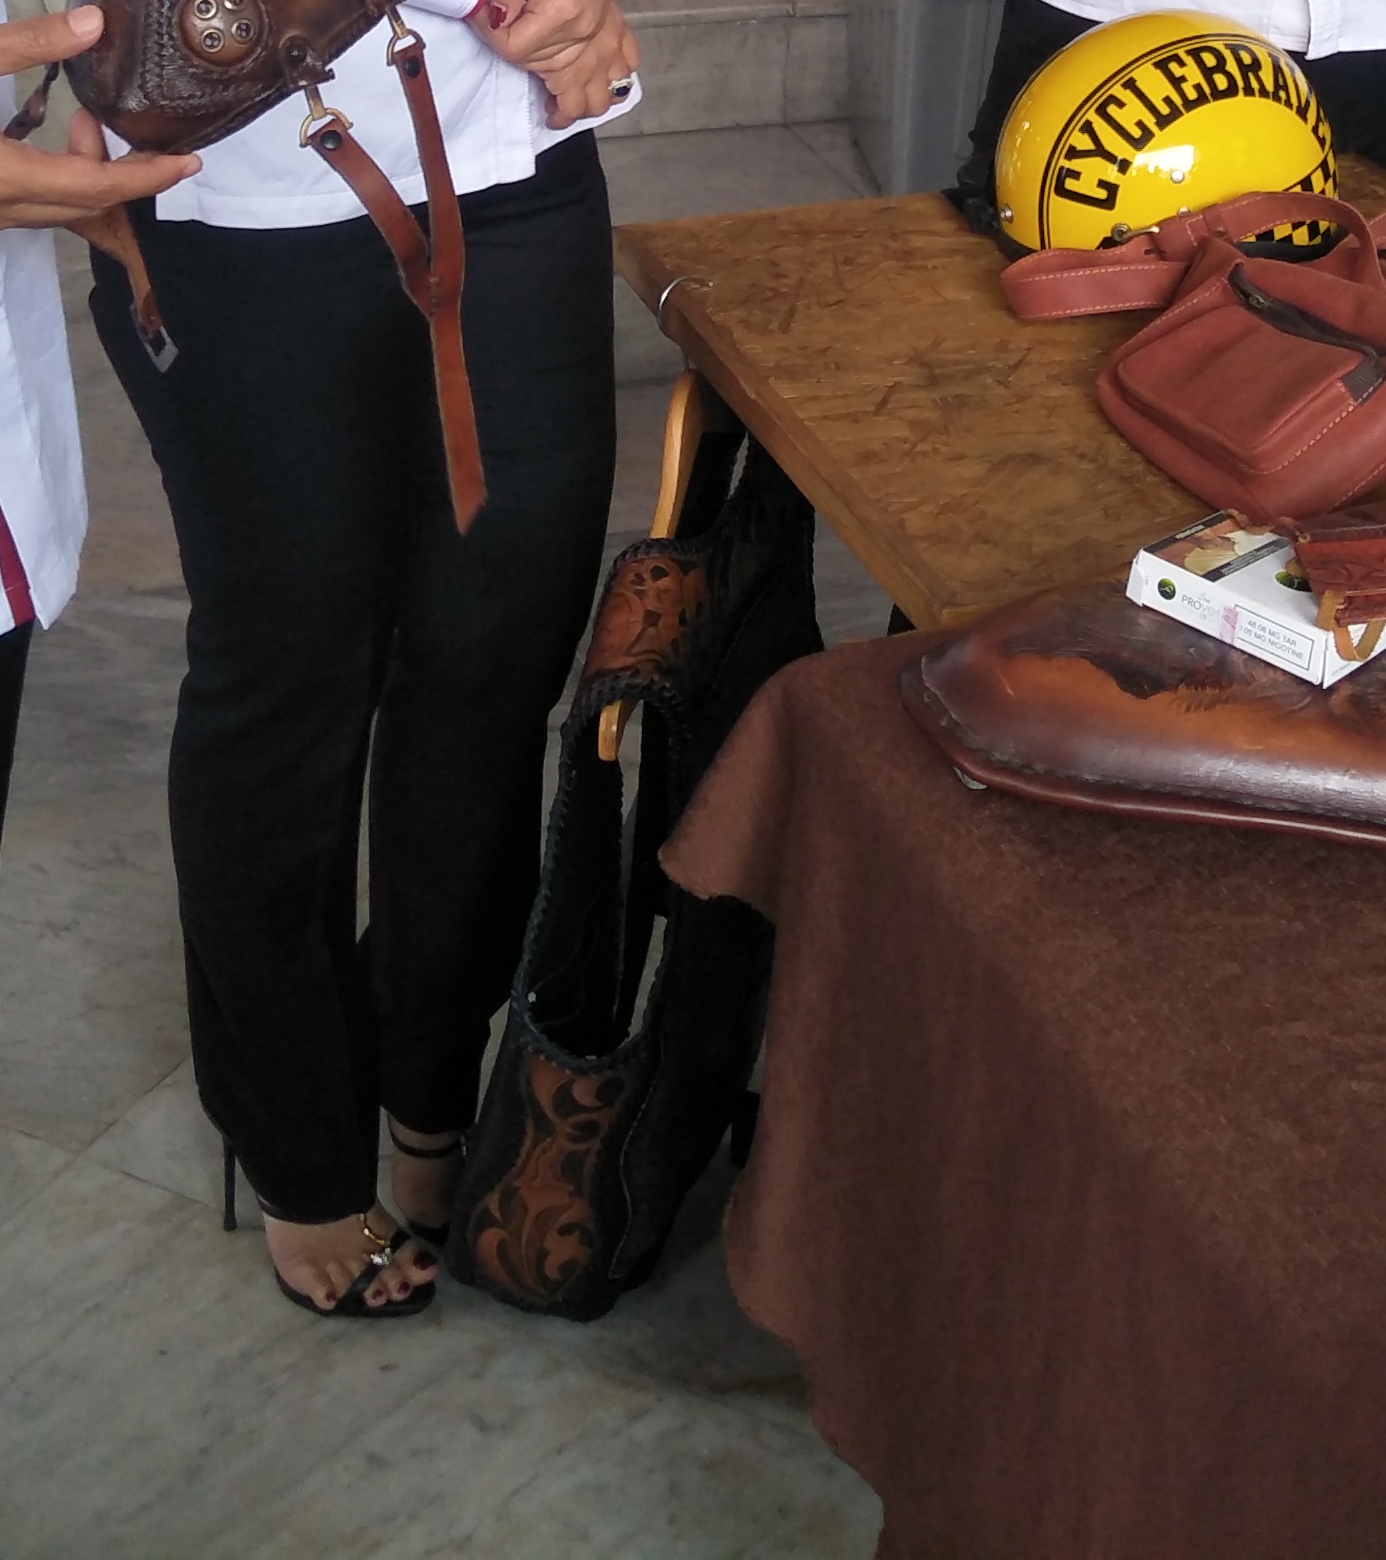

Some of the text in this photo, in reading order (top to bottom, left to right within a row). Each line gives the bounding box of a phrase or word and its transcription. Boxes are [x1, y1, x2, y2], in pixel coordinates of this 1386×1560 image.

[1181, 594, 1223, 617] PROVOS
[1268, 637, 1305, 660] NICOTINE
[1282, 635, 1298, 648] TAR
